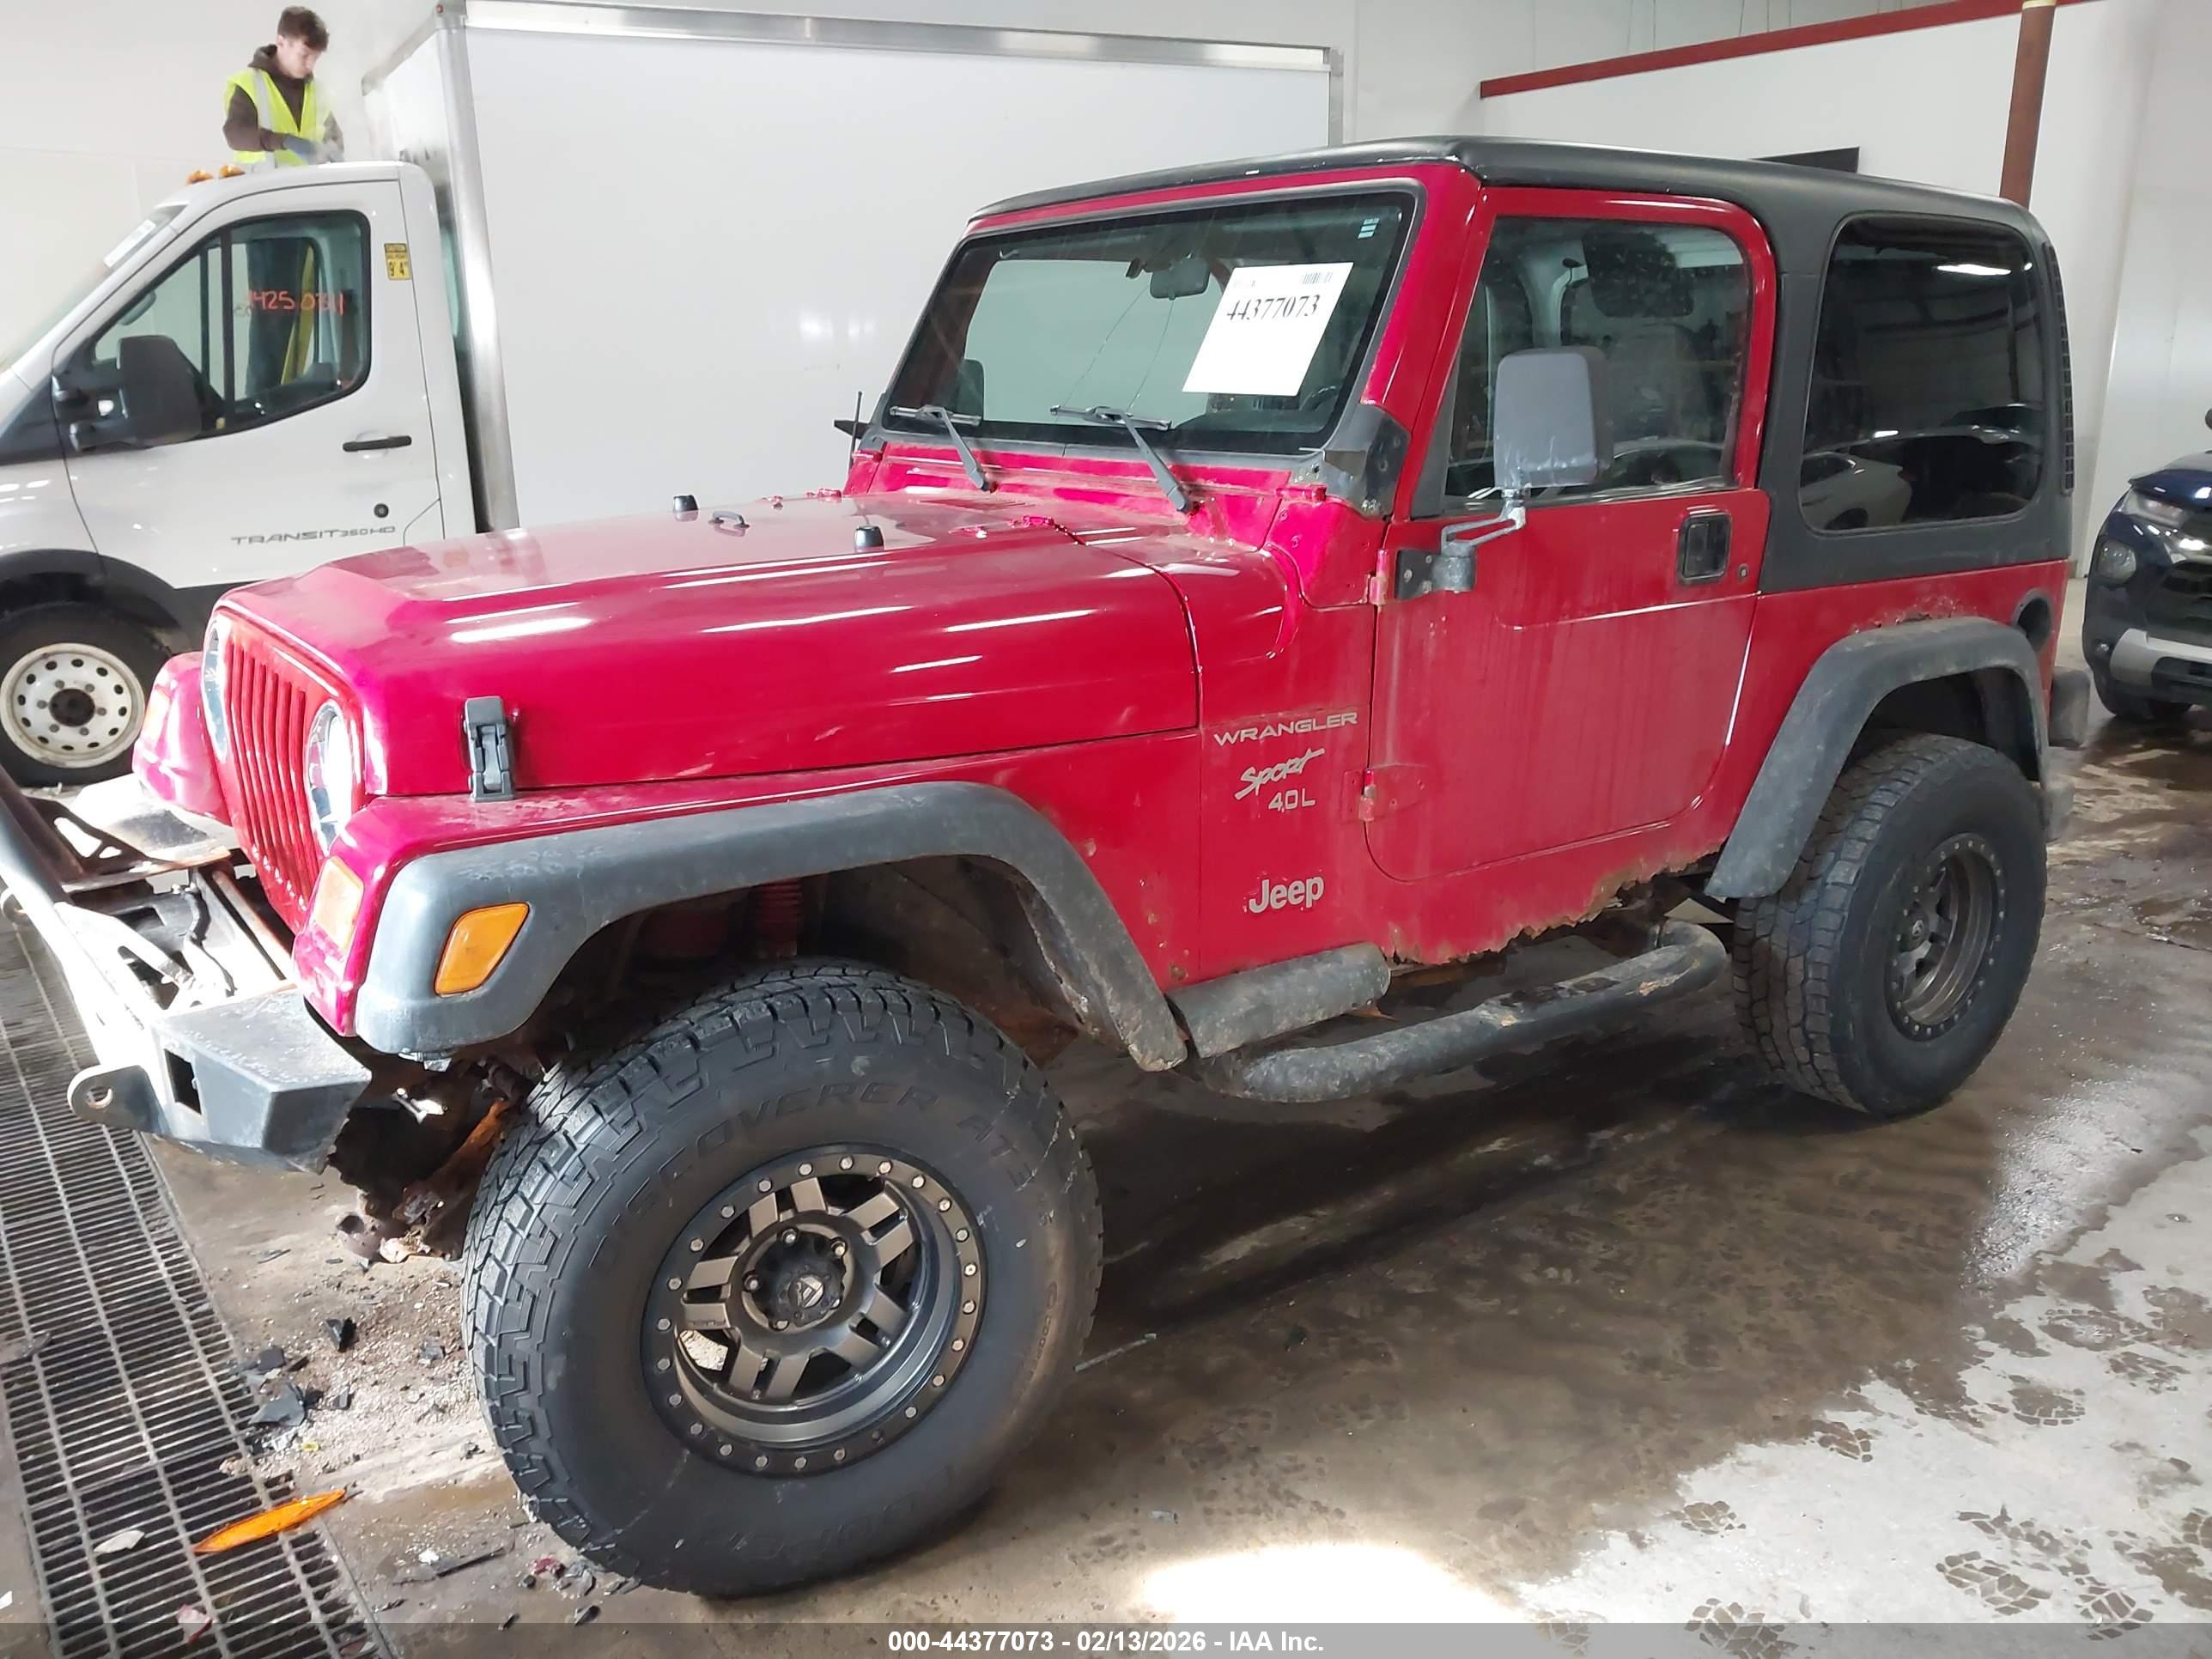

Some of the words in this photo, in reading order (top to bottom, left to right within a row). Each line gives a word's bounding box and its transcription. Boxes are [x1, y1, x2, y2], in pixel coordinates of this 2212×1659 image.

[1227, 295, 1321, 320] 44377073
[231, 529, 340, 545] TRANSIT
[1213, 712, 1358, 746] WRANGLER
[1234, 747, 1326, 800] Sport
[1249, 875, 1325, 914] Jeep
